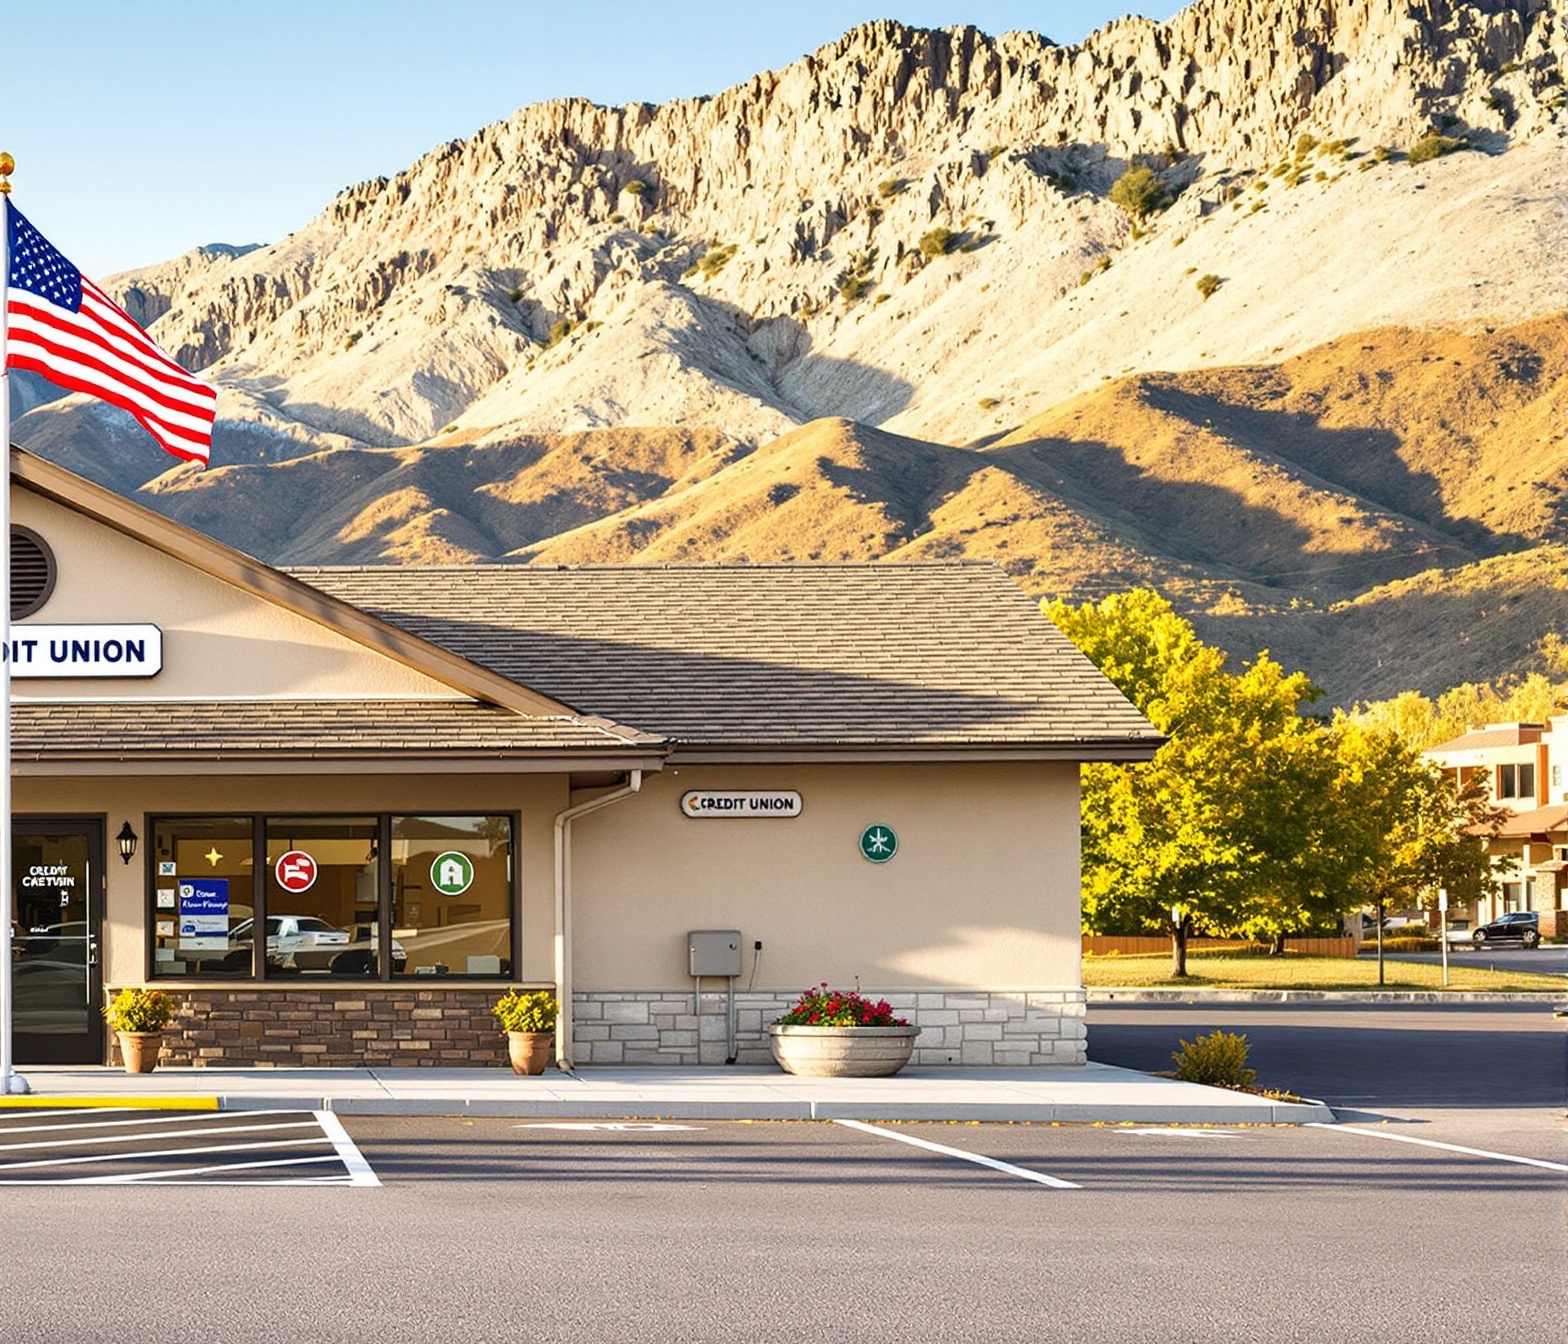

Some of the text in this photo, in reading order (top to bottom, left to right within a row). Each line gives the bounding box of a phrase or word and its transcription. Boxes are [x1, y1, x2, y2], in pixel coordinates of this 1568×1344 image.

[50, 639, 145, 663] UNION
[701, 798, 794, 810] CREDIT UNION
